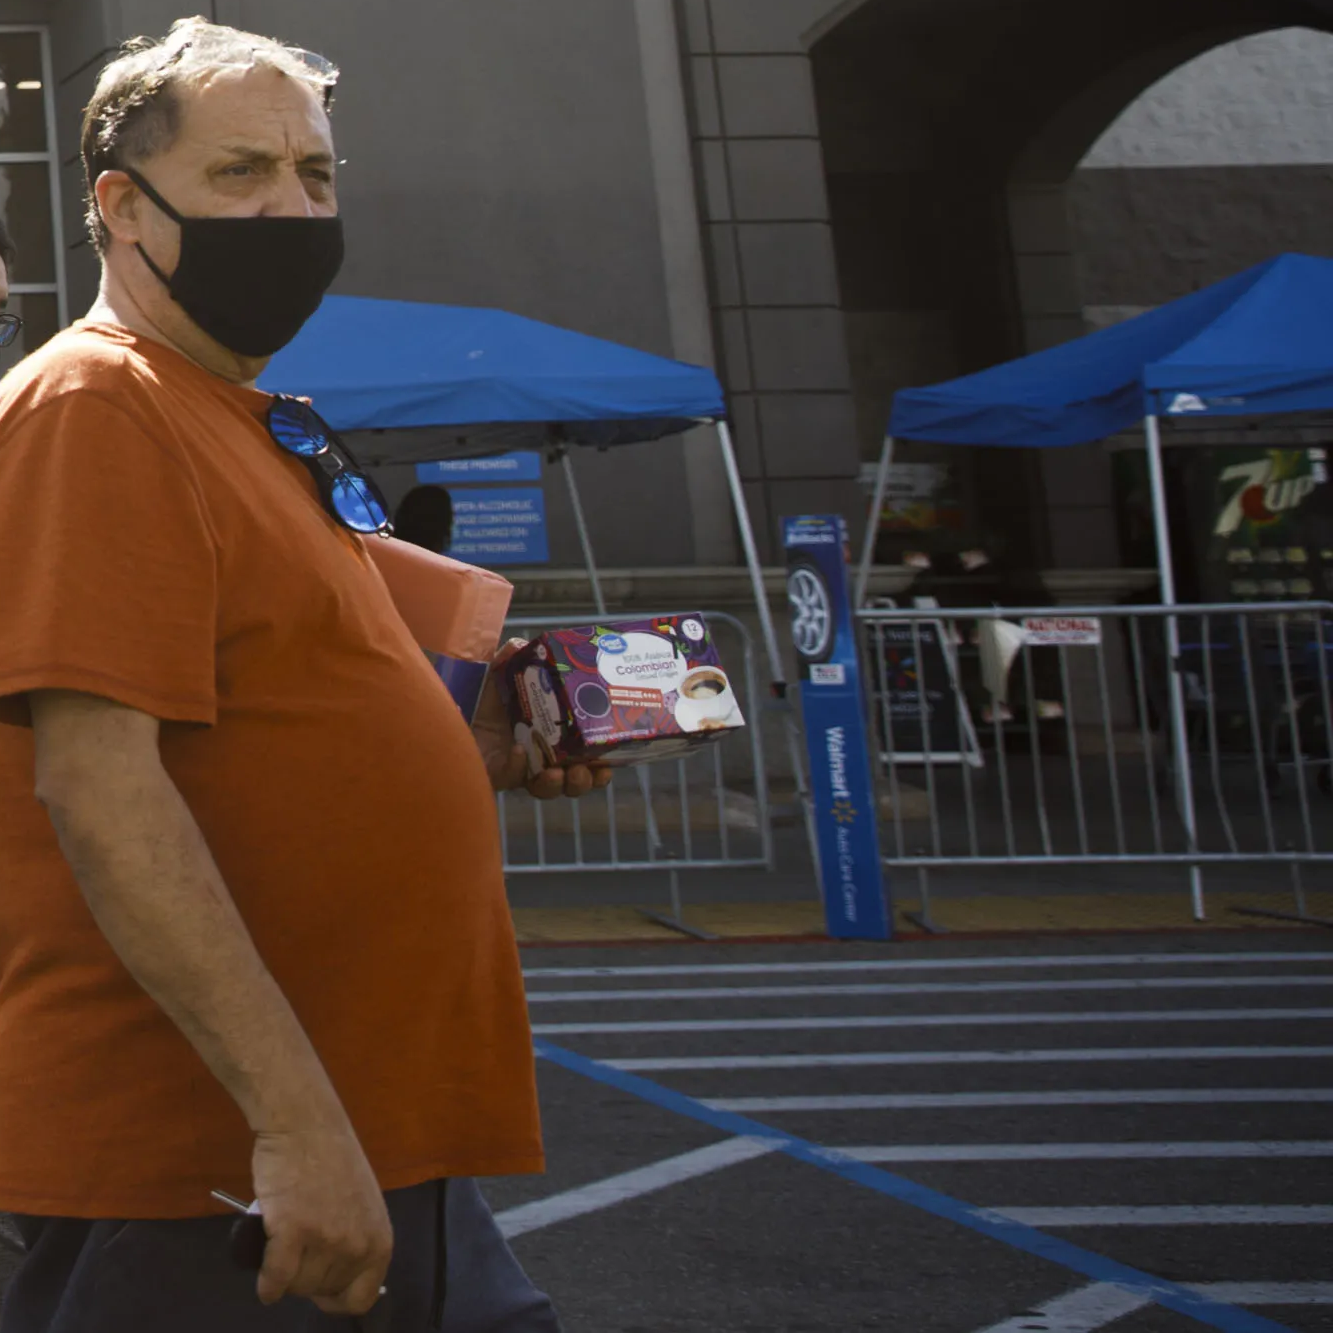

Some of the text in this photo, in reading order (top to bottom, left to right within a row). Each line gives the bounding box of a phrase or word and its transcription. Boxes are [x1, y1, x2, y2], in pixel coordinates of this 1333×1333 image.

[615, 659, 678, 676] Colombian
[825, 726, 860, 923] Walmart Auto Care Center
